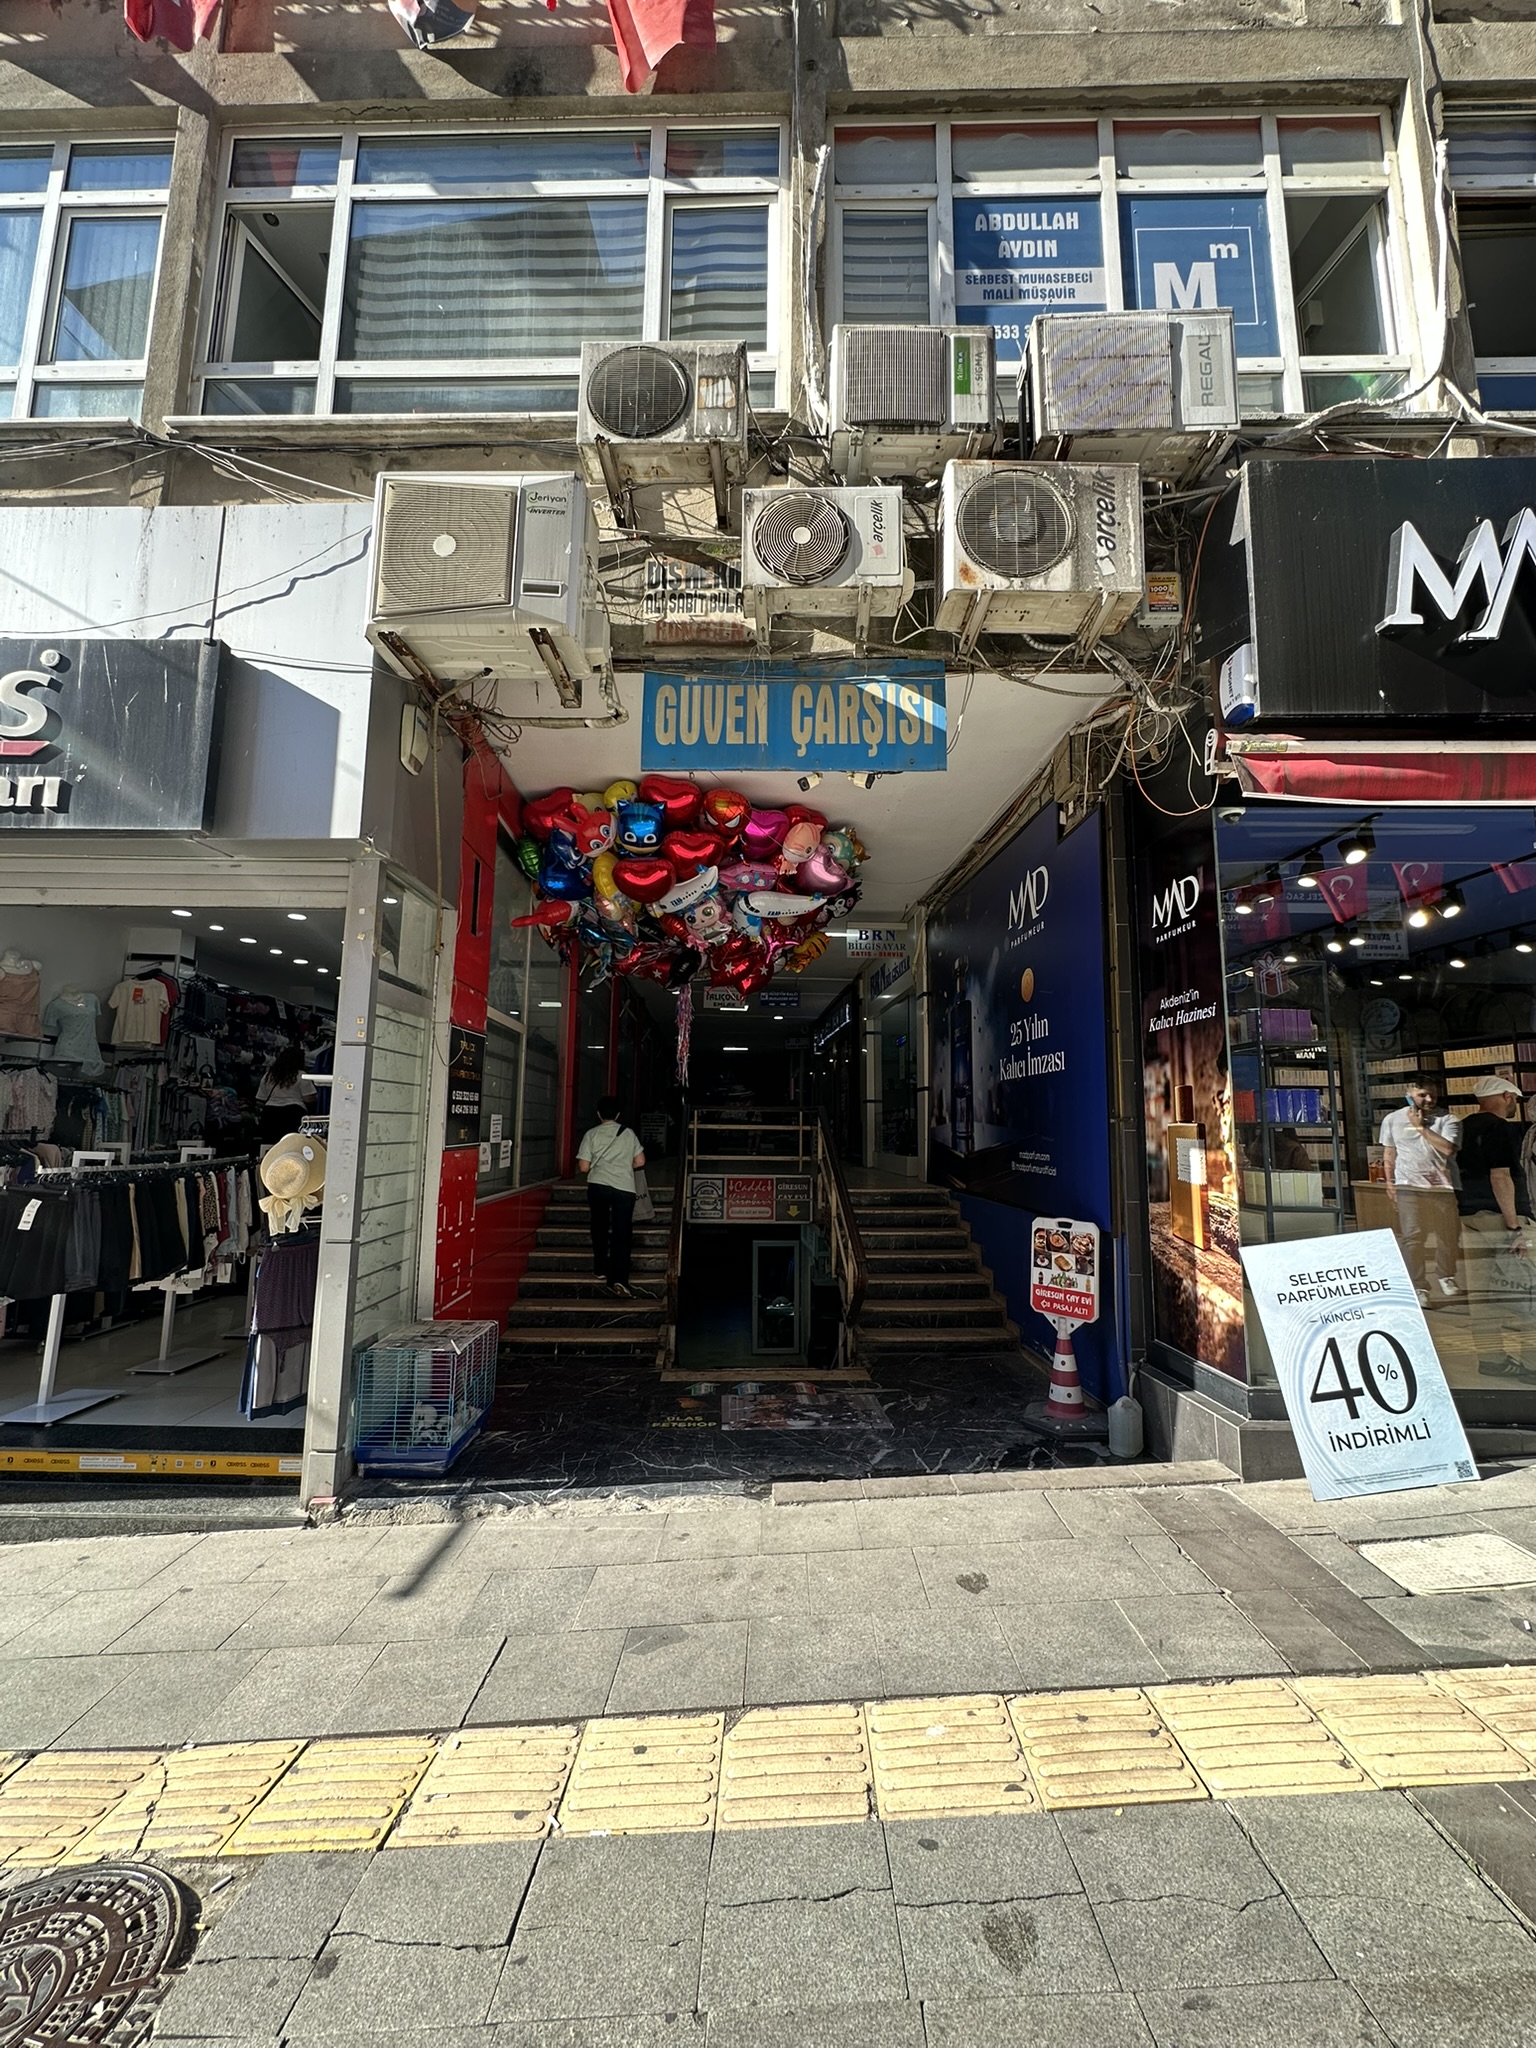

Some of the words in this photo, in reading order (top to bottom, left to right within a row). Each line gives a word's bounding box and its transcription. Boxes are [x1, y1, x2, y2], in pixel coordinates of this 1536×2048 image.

[975, 212, 1079, 232] ABDULLAH
[998, 240, 1058, 258] AYDIN
[965, 274, 1015, 285] SERBEST
[1018, 271, 1093, 285] MUHASEBECİ
[1153, 262, 1218, 308] M
[983, 287, 1014, 300] MALİ
[1020, 286, 1076, 302] MÜŞAVİR
[1200, 326, 1213, 407] REGAL
[870, 500, 884, 543] arçelik
[1096, 471, 1121, 551] arçelik
[669, 590, 706, 613] SABİT
[655, 675, 768, 746] GÜVEN
[791, 682, 935, 760] ÇARŞISI
[1007, 865, 1049, 930] MAD
[1152, 875, 1200, 928] MAD
[860, 930, 896, 941] BRN
[1010, 921, 1045, 949] PARFUMEUR
[1156, 920, 1197, 944] PARFUMEUR
[1160, 988, 1200, 1010] Akdeniz'in
[1149, 1017, 1173, 1032] Kalıcı
[1175, 1002, 1217, 1026] Hazinesi
[1010, 1020, 1023, 1046] 25
[1023, 1013, 1049, 1042] Yılın
[1000, 1055, 1025, 1081] Kalıcı
[1028, 1046, 1065, 1076] İmzası
[734, 1180, 767, 1192] Cadde
[777, 1182, 808, 1191] GİRESUN
[1289, 1266, 1368, 1287] SELECTIVE
[1035, 1287, 1064, 1300] GİRESUN
[1081, 1297, 1092, 1306] EVİ
[1277, 1279, 1391, 1304] PARFÜMLERDE
[1053, 1300, 1073, 1313] PASAJ
[1074, 1307, 1088, 1315] ALTI
[1320, 1308, 1365, 1325] İKİNCİSİ
[1310, 1330, 1418, 1420] 40
[1378, 1363, 1398, 1381] %
[1328, 1418, 1431, 1452] İNDİRİMLİ
